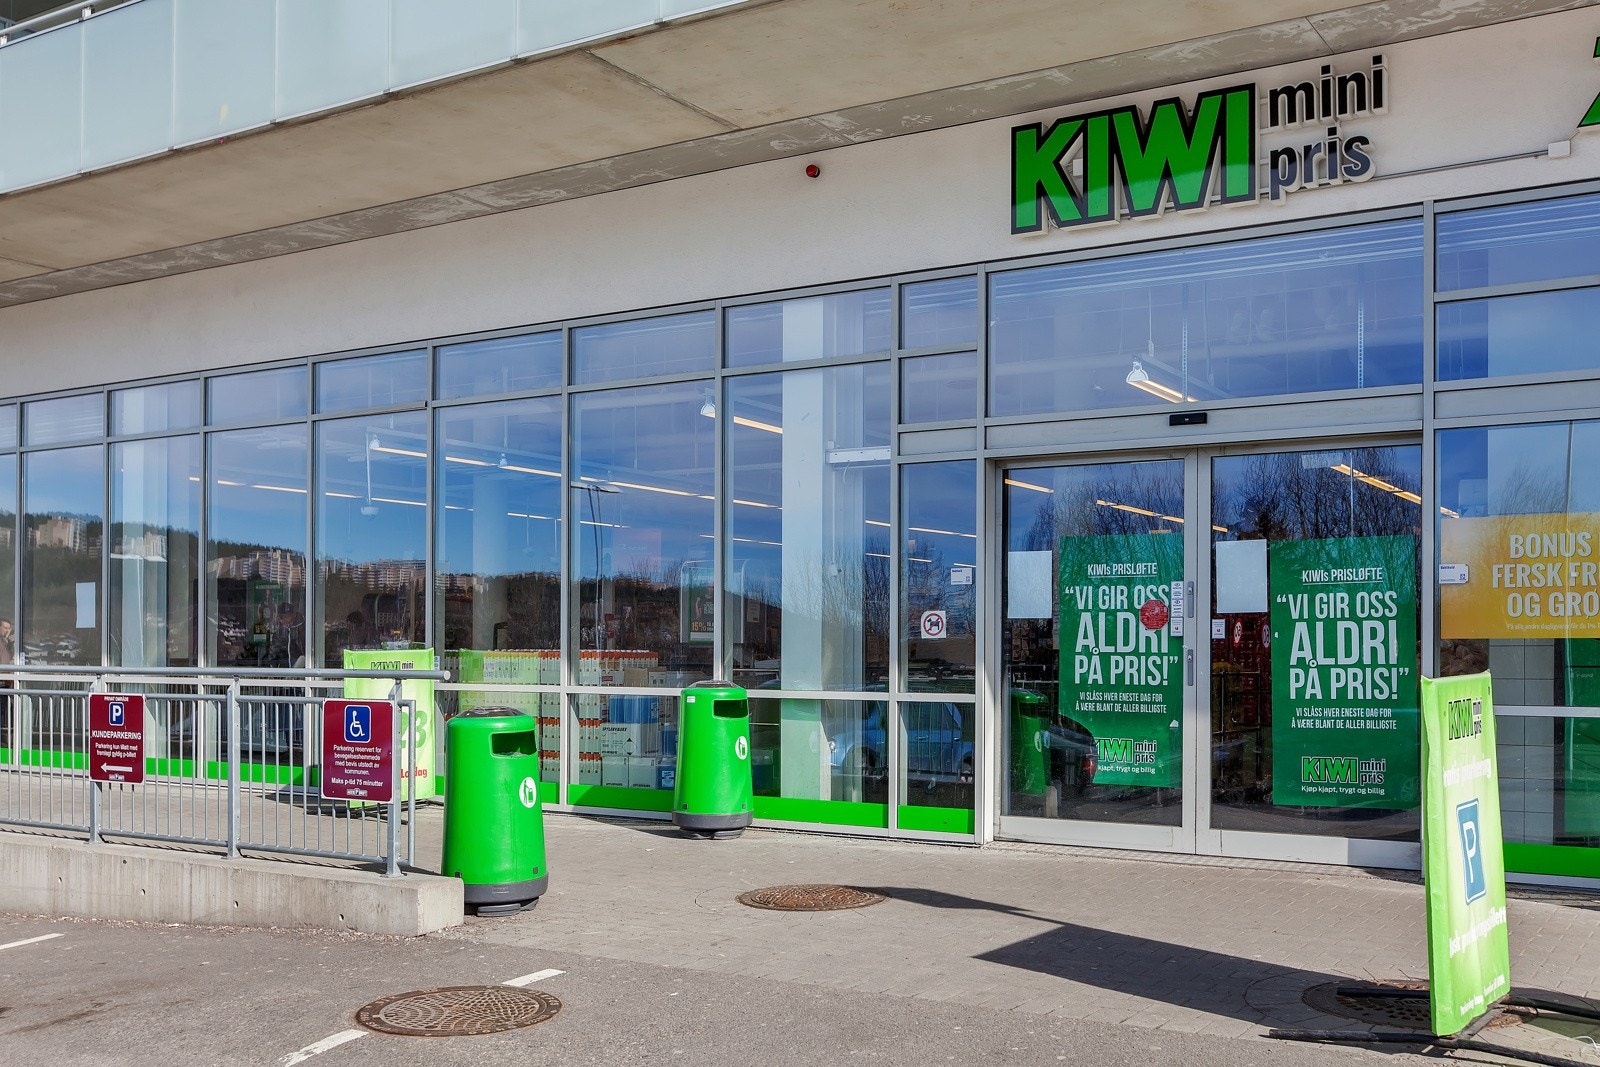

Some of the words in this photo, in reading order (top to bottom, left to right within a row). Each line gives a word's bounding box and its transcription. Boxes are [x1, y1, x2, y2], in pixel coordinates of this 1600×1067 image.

[1011, 83, 1256, 234] KIWI
[1268, 54, 1385, 128] mini
[1268, 126, 1374, 201] pris
[1509, 532, 1592, 559] BONUS
[1087, 564, 1111, 576] KIWIs
[1112, 562, 1158, 575] PRISLØFTE
[1302, 570, 1328, 582] KIWIs
[1331, 568, 1382, 581] PRISLØFTE
[1492, 562, 1563, 588] FERSK
[1569, 562, 1600, 587] FR
[1098, 585, 1128, 610] GIR
[1133, 584, 1170, 610] OSS
[1315, 592, 1350, 619] GIR
[1356, 590, 1398, 618] OSS
[1507, 592, 1541, 618] OG
[1075, 612, 1169, 653] ALDRI
[1290, 620, 1398, 666] ALDRI
[402, 660, 414, 670] mini
[1074, 647, 1103, 684] PÅ
[1290, 660, 1323, 700] PÅ
[1080, 692, 1086, 700] VI
[1086, 690, 1103, 701] SLÅSS
[1104, 692, 1118, 701] HVER
[1119, 692, 1139, 701] ENESTE
[1140, 692, 1151, 702] DAG
[1152, 693, 1163, 703] FOR
[112, 705, 122, 722] P
[1075, 700, 1080, 711] Å
[1080, 702, 1095, 711] VÆRE
[1096, 703, 1114, 712] BLANT
[1115, 703, 1122, 712] DE
[1122, 704, 1140, 713] ALLER
[1140, 704, 1167, 714] BILLIGSTE
[1296, 708, 1302, 716] VI
[1303, 706, 1322, 717] SLÅSS
[1324, 708, 1340, 717] HVER
[1341, 708, 1364, 718] ENESTE
[1366, 708, 1378, 718] DAG
[1380, 708, 1392, 718] FOR
[1291, 717, 1296, 728] Å
[1297, 719, 1314, 729] VÆRE
[1315, 719, 1334, 729] BLANT
[1336, 720, 1344, 729] DE
[1345, 720, 1365, 729] ALLER
[1366, 720, 1397, 730] BILLIGSTE
[1448, 698, 1474, 740] KIWI
[92, 730, 142, 740] KUNDEPARKERING
[95, 742, 112, 750] Parkering
[333, 744, 354, 753] Parkering
[1095, 737, 1133, 763] IWI
[1135, 740, 1157, 752] mini
[1134, 752, 1155, 765] pris
[1140, 766, 1156, 774] billig
[1302, 756, 1358, 783] KIWI
[1360, 758, 1386, 772] mini
[344, 778, 356, 786] p-tid
[1360, 772, 1384, 786] pris
[1301, 786, 1318, 794] Kjøp
[1318, 786, 1338, 794] kjapt,
[1339, 786, 1356, 794] trygt
[1368, 787, 1385, 796] billig
[1462, 820, 1476, 884] P
